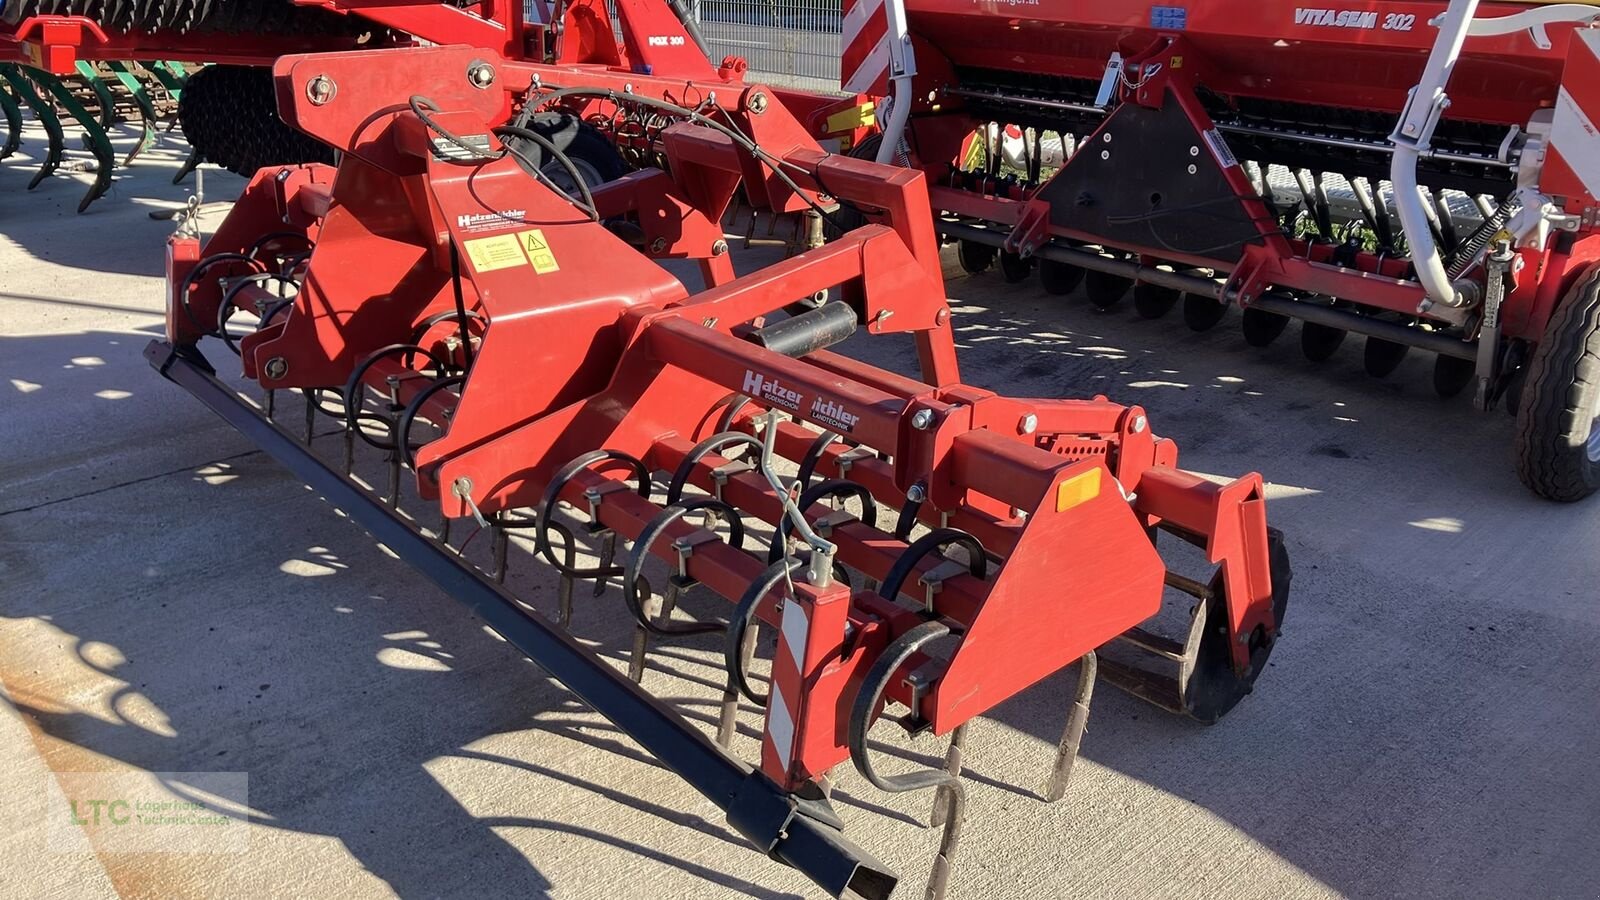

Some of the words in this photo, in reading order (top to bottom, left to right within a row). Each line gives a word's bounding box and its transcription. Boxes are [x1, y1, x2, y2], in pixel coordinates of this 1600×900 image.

[1295, 8, 1378, 29] VITASEM
[1382, 13, 1416, 31] 302
[669, 36, 685, 46] 300
[812, 412, 849, 431] LANDTECHNIK
